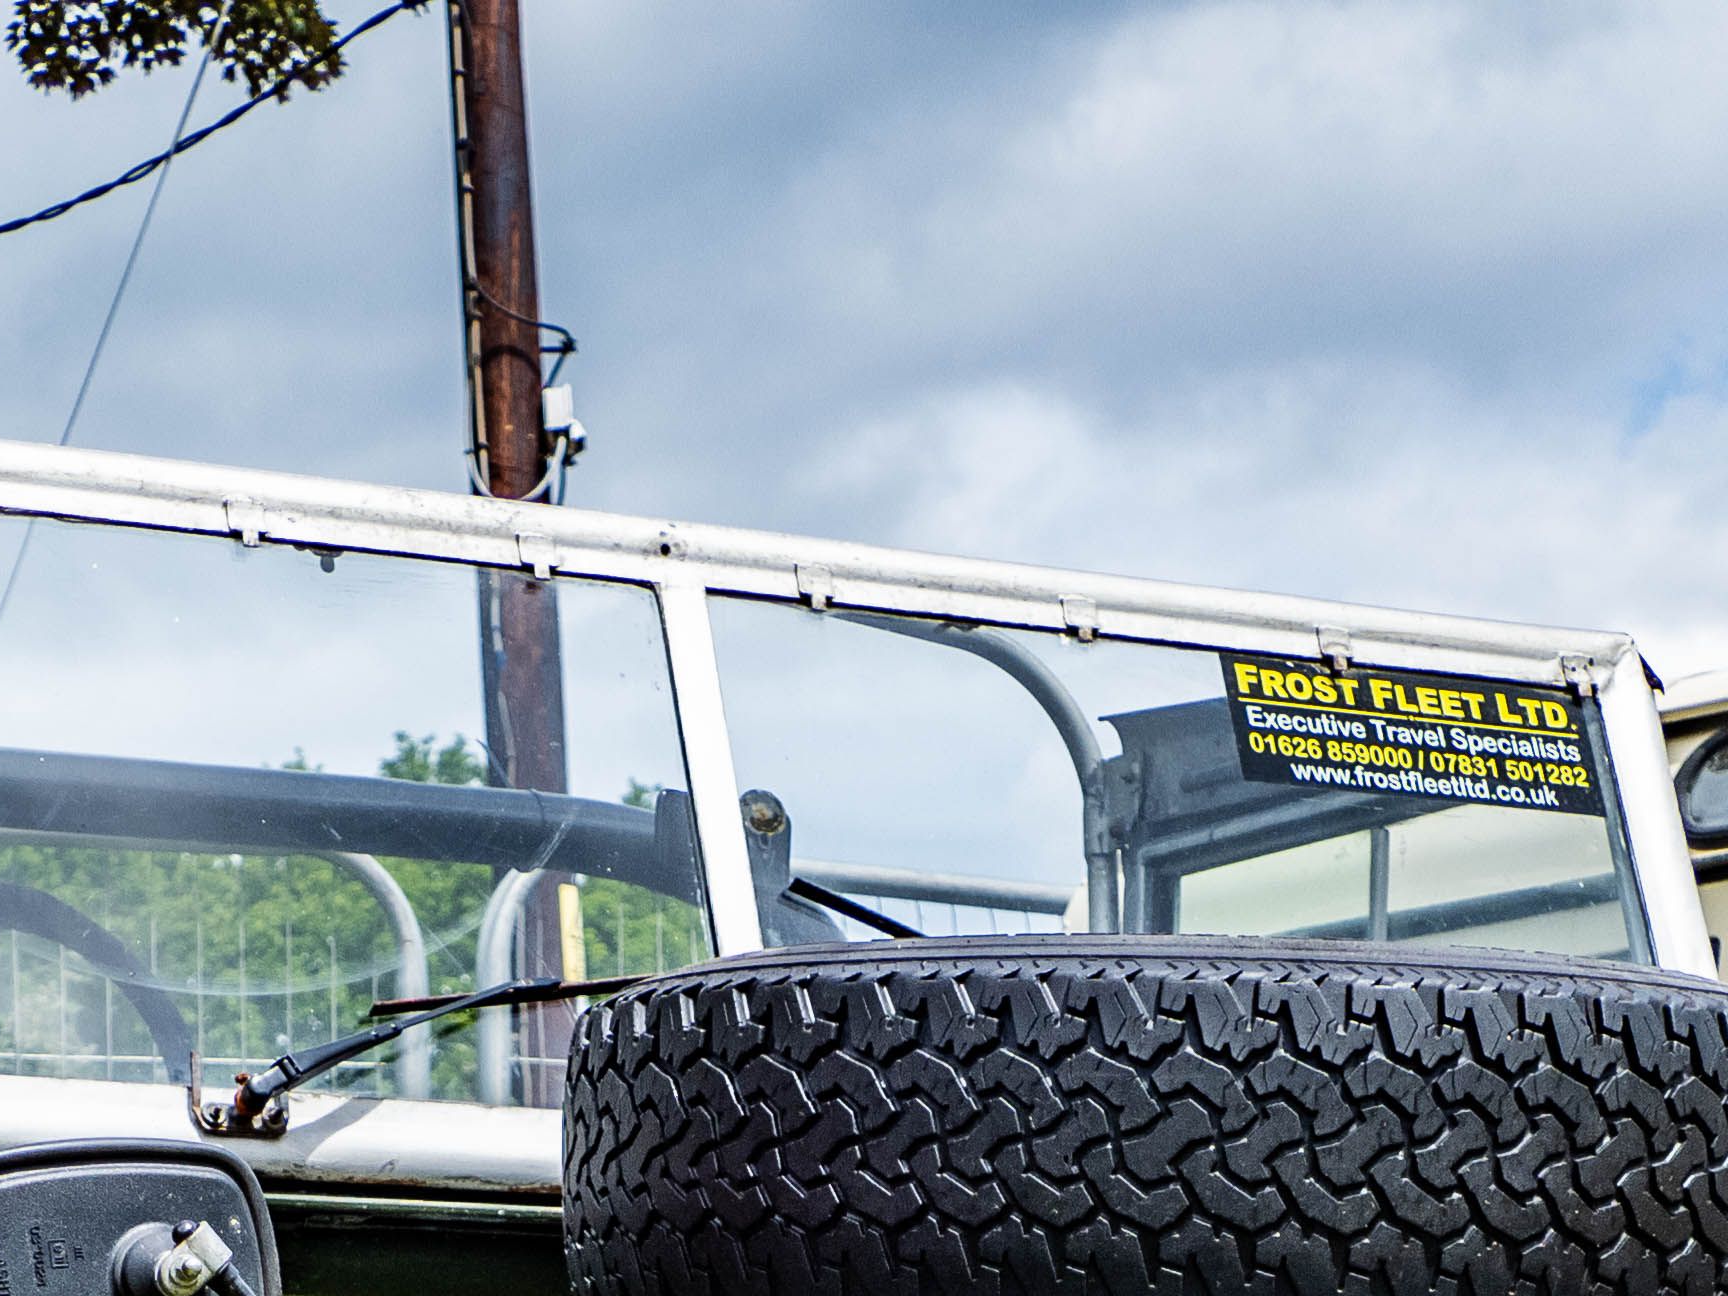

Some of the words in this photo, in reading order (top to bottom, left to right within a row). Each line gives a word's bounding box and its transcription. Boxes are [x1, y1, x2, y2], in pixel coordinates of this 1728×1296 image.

[1233, 662, 1358, 705] FROST
[1368, 680, 1485, 719] FLEET
[1499, 693, 1578, 730] LTD.
[1245, 705, 1366, 740] Executive
[1368, 719, 1446, 749] Travel
[1451, 729, 1581, 763] Specialists
[1248, 732, 1322, 759] 01626
[1327, 740, 1411, 768] 859000
[1429, 752, 1498, 779] 07831
[1506, 759, 1590, 788] 501282
[1290, 762, 1560, 807] www.frostfleetltd.co.uk
